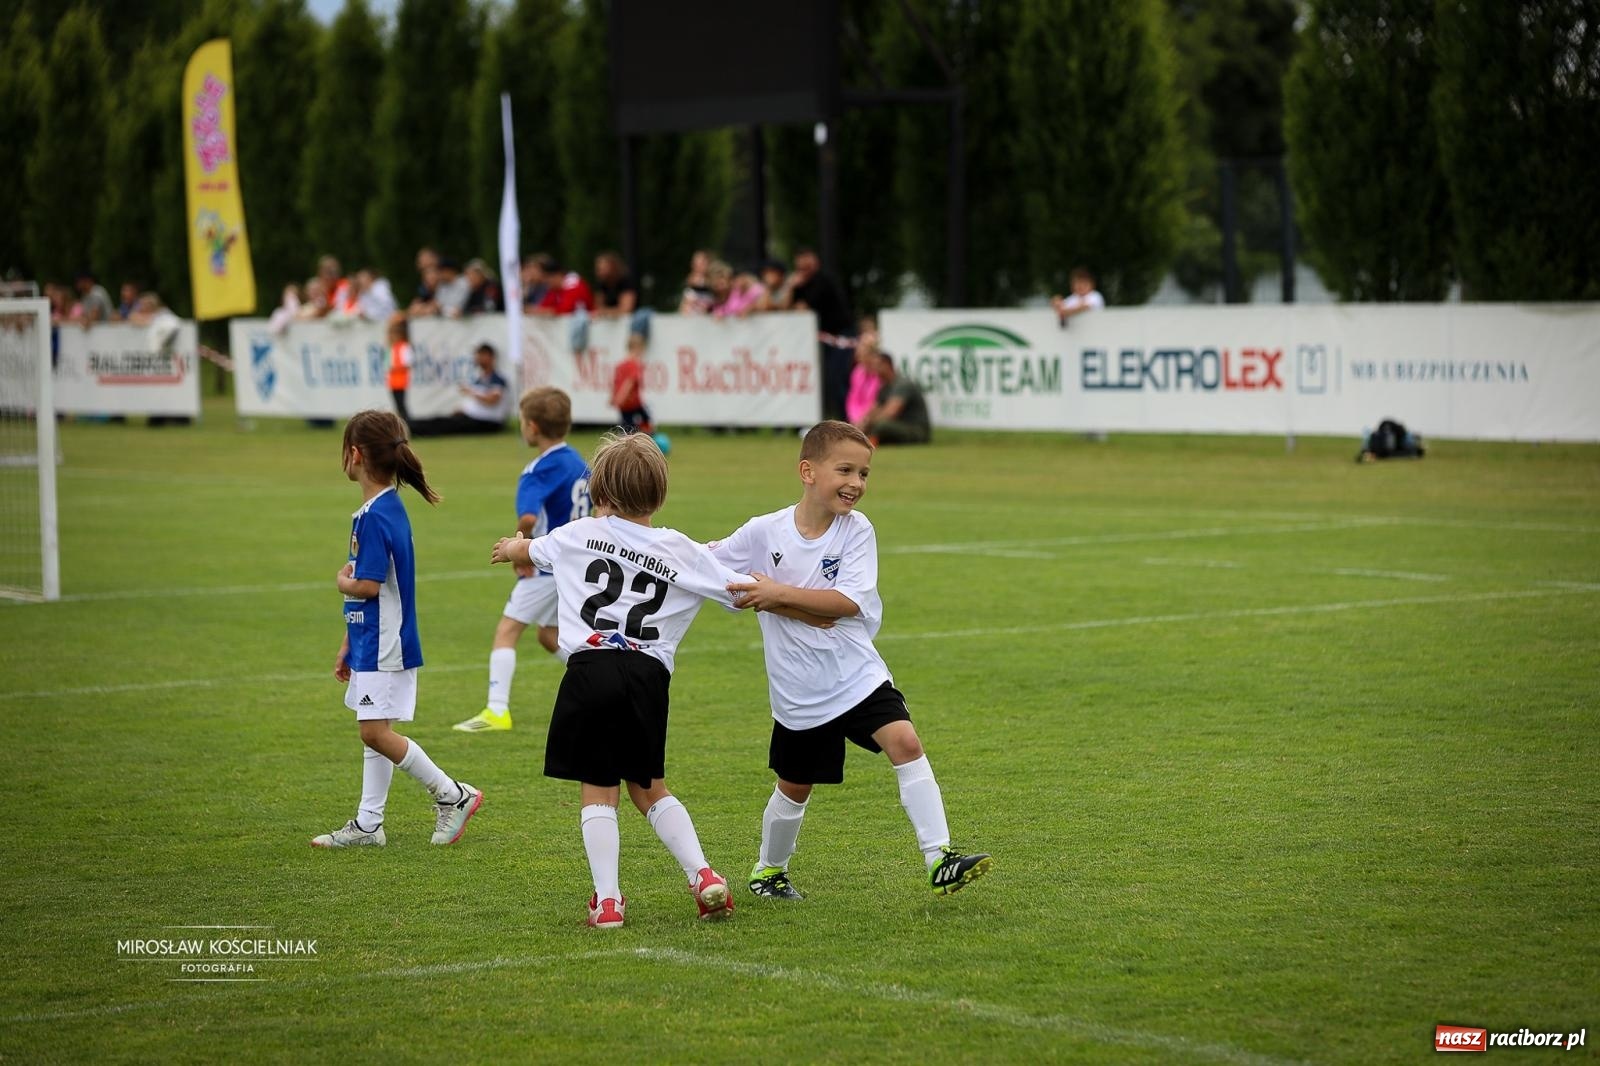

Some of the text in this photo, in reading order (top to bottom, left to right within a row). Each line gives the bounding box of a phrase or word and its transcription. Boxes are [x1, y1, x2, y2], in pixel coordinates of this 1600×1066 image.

[676, 345, 814, 393] Racibórz
[1082, 348, 1282, 391] ELEKTROLEX
[580, 558, 669, 640] 22
